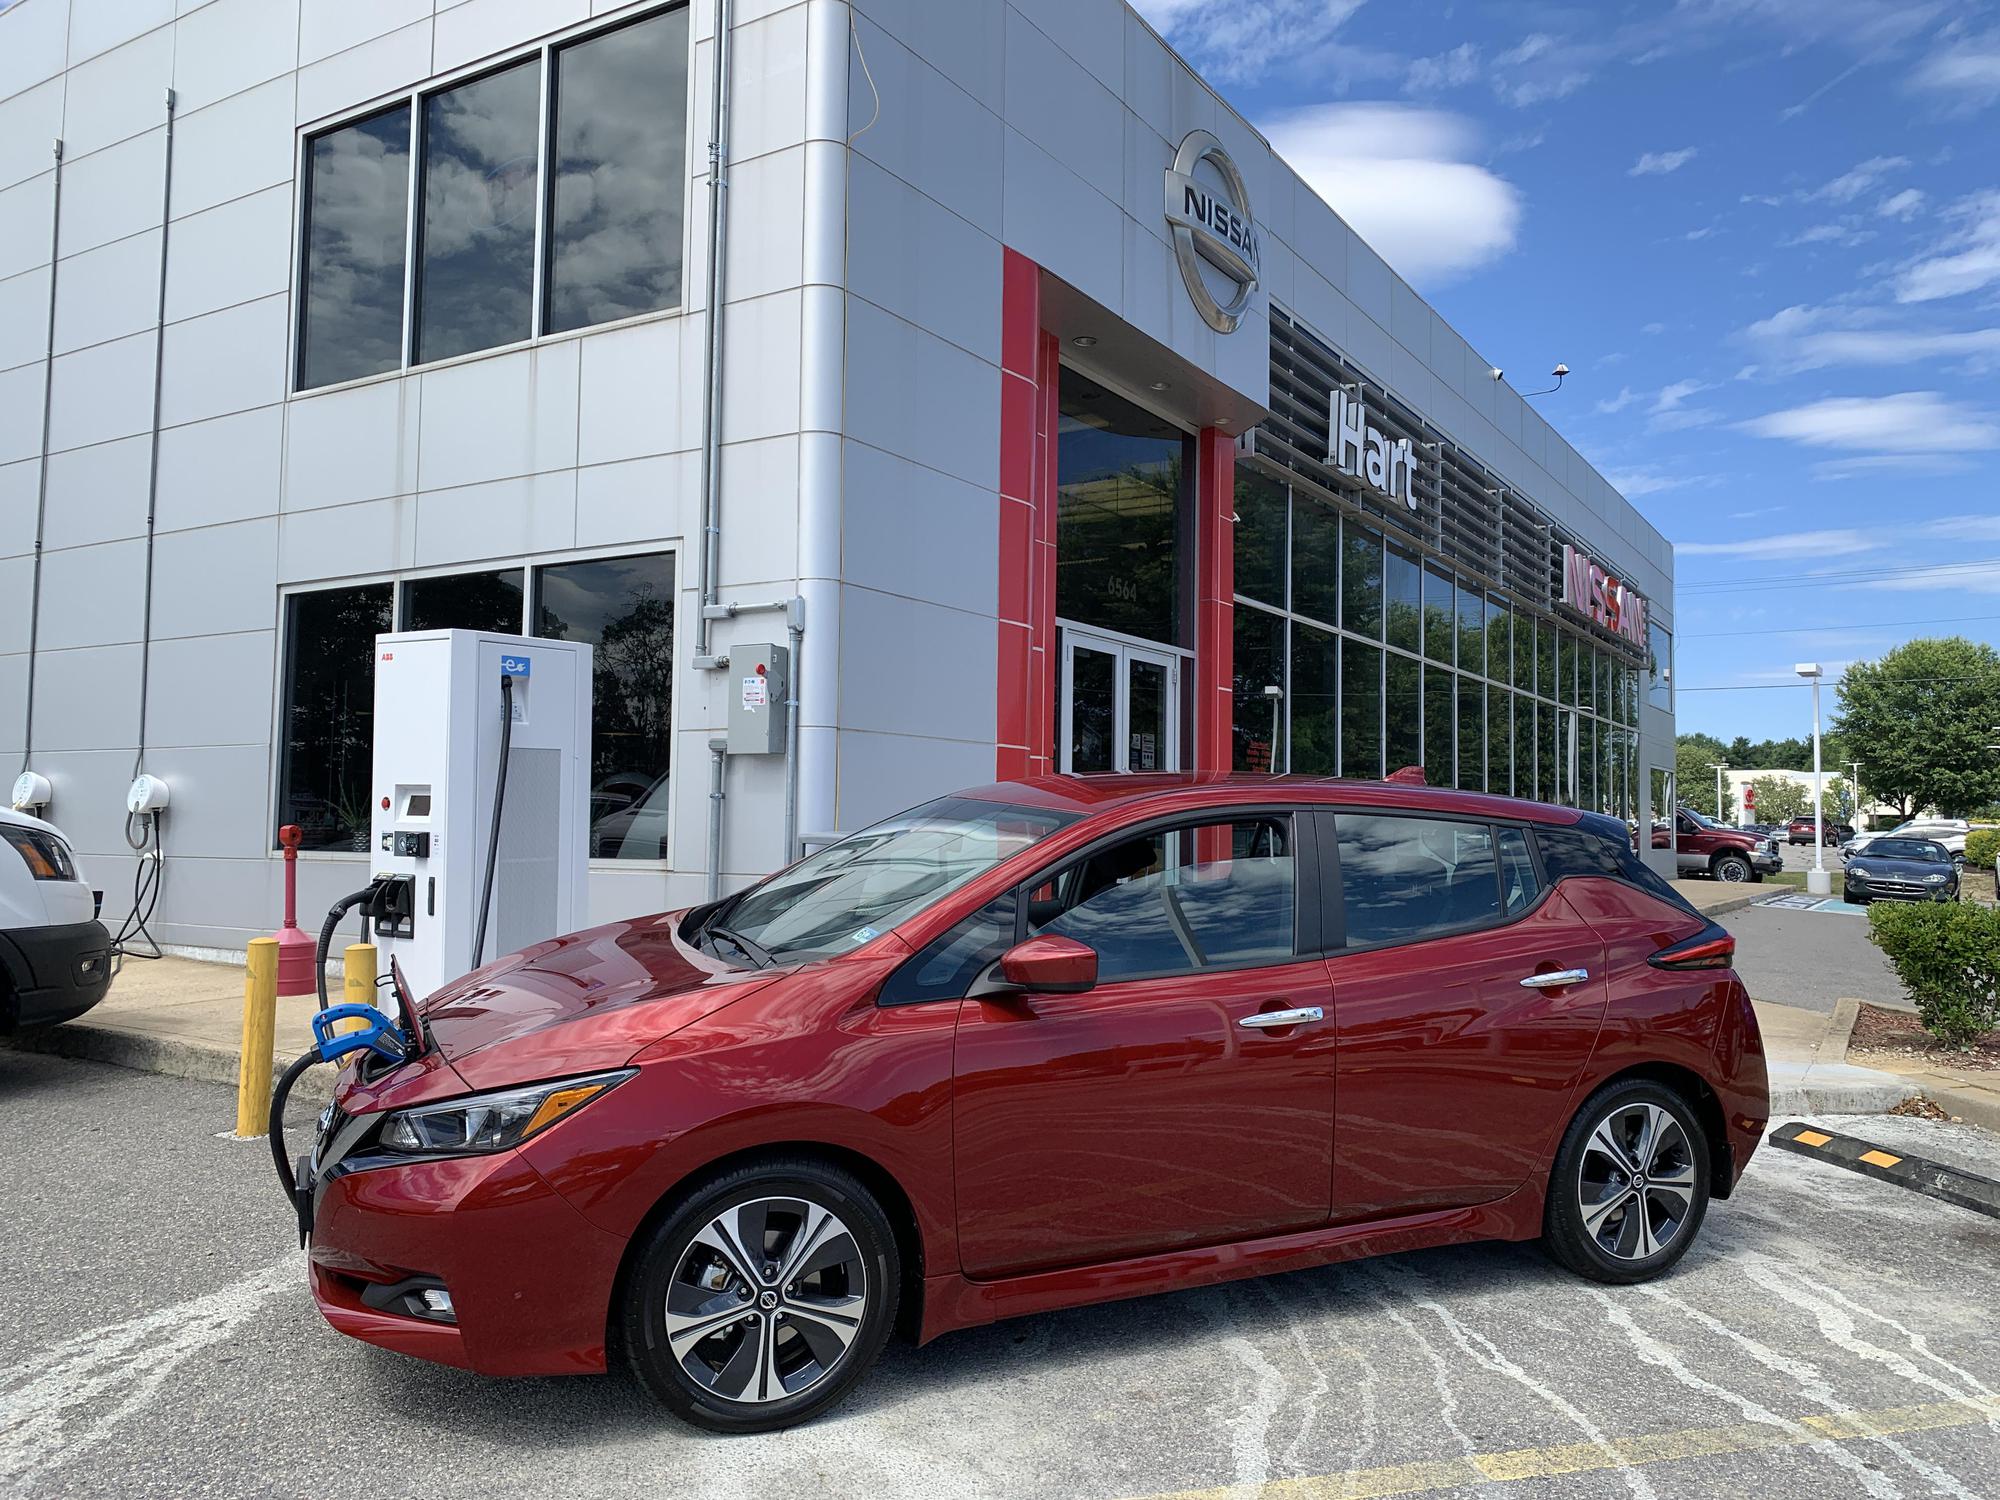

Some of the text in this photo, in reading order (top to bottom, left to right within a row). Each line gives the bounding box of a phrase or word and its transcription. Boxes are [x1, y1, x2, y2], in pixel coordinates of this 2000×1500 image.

[1330, 390, 1417, 511] Hart
[1107, 575, 1137, 602] 6564
[1563, 544, 1644, 648] NISSAN
